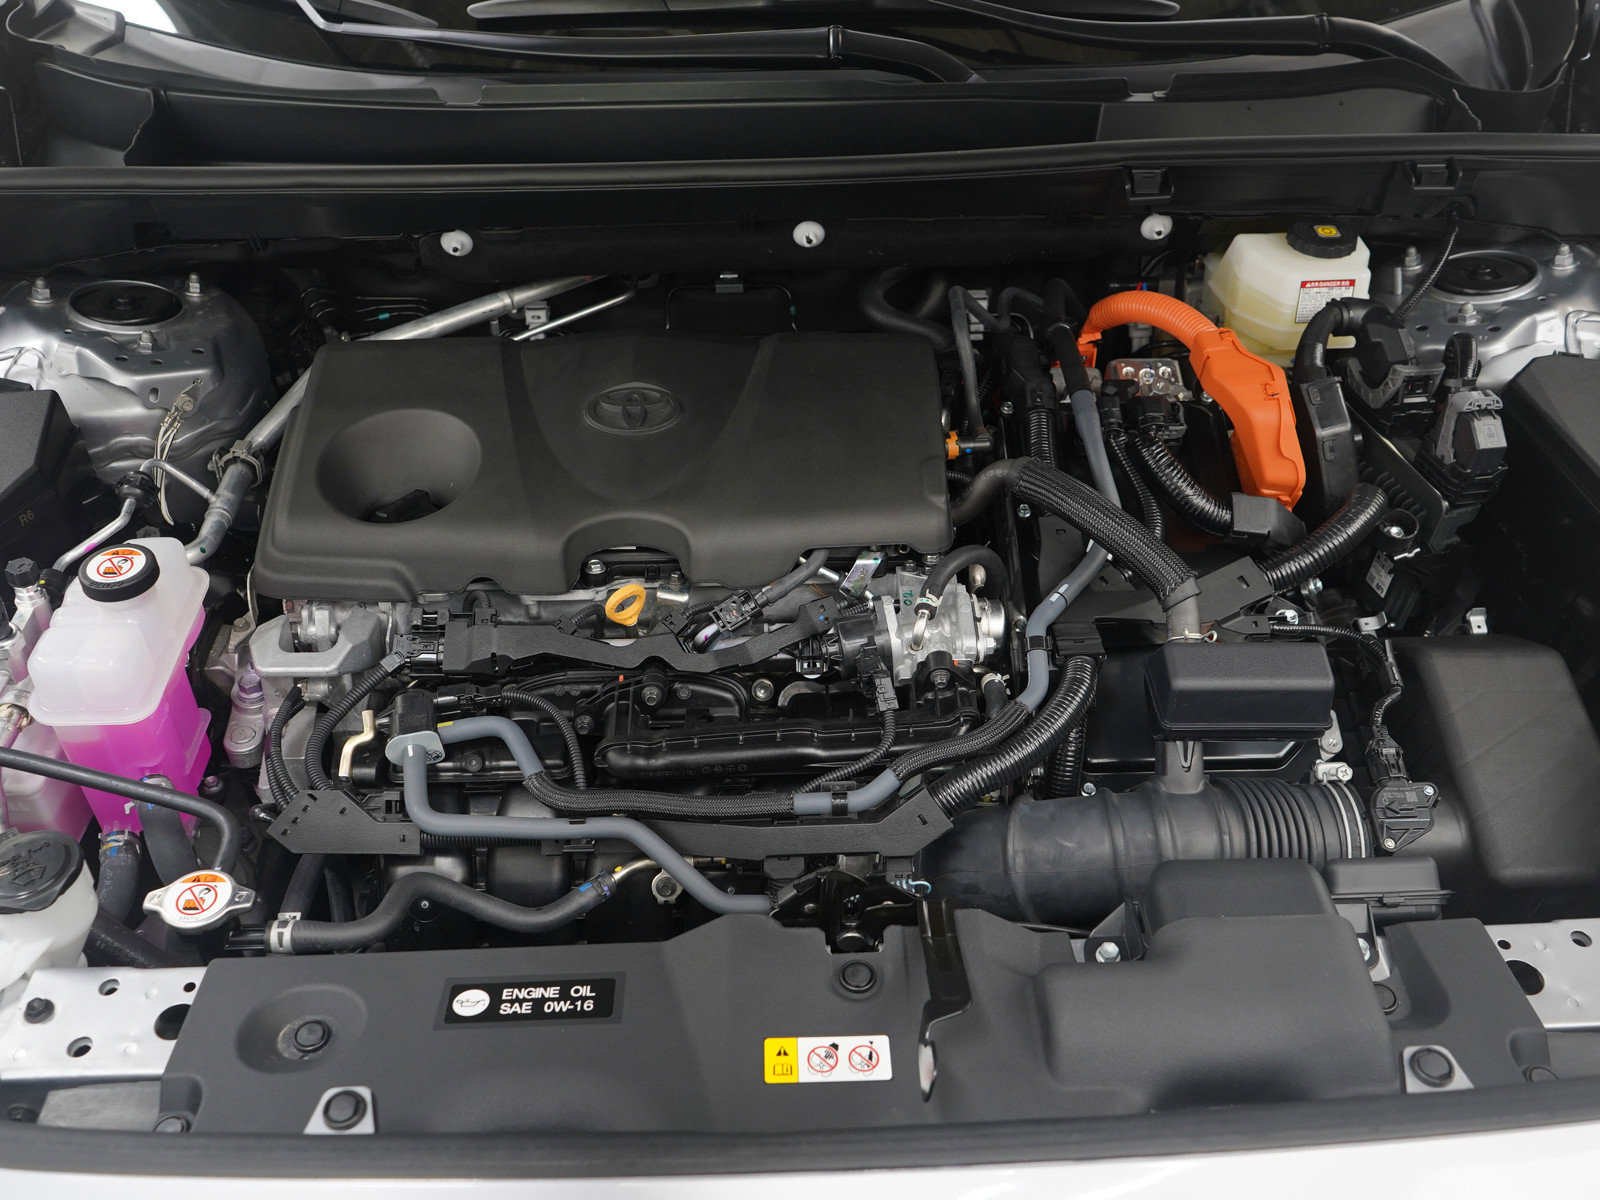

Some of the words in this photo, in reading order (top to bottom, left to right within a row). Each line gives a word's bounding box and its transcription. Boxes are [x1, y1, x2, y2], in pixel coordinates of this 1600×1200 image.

[19, 510, 35, 526] R6
[502, 987, 561, 999] ENGINE
[570, 985, 596, 998] OIL
[499, 1002, 533, 1014] SAE
[544, 1000, 594, 1013] 0W-16
